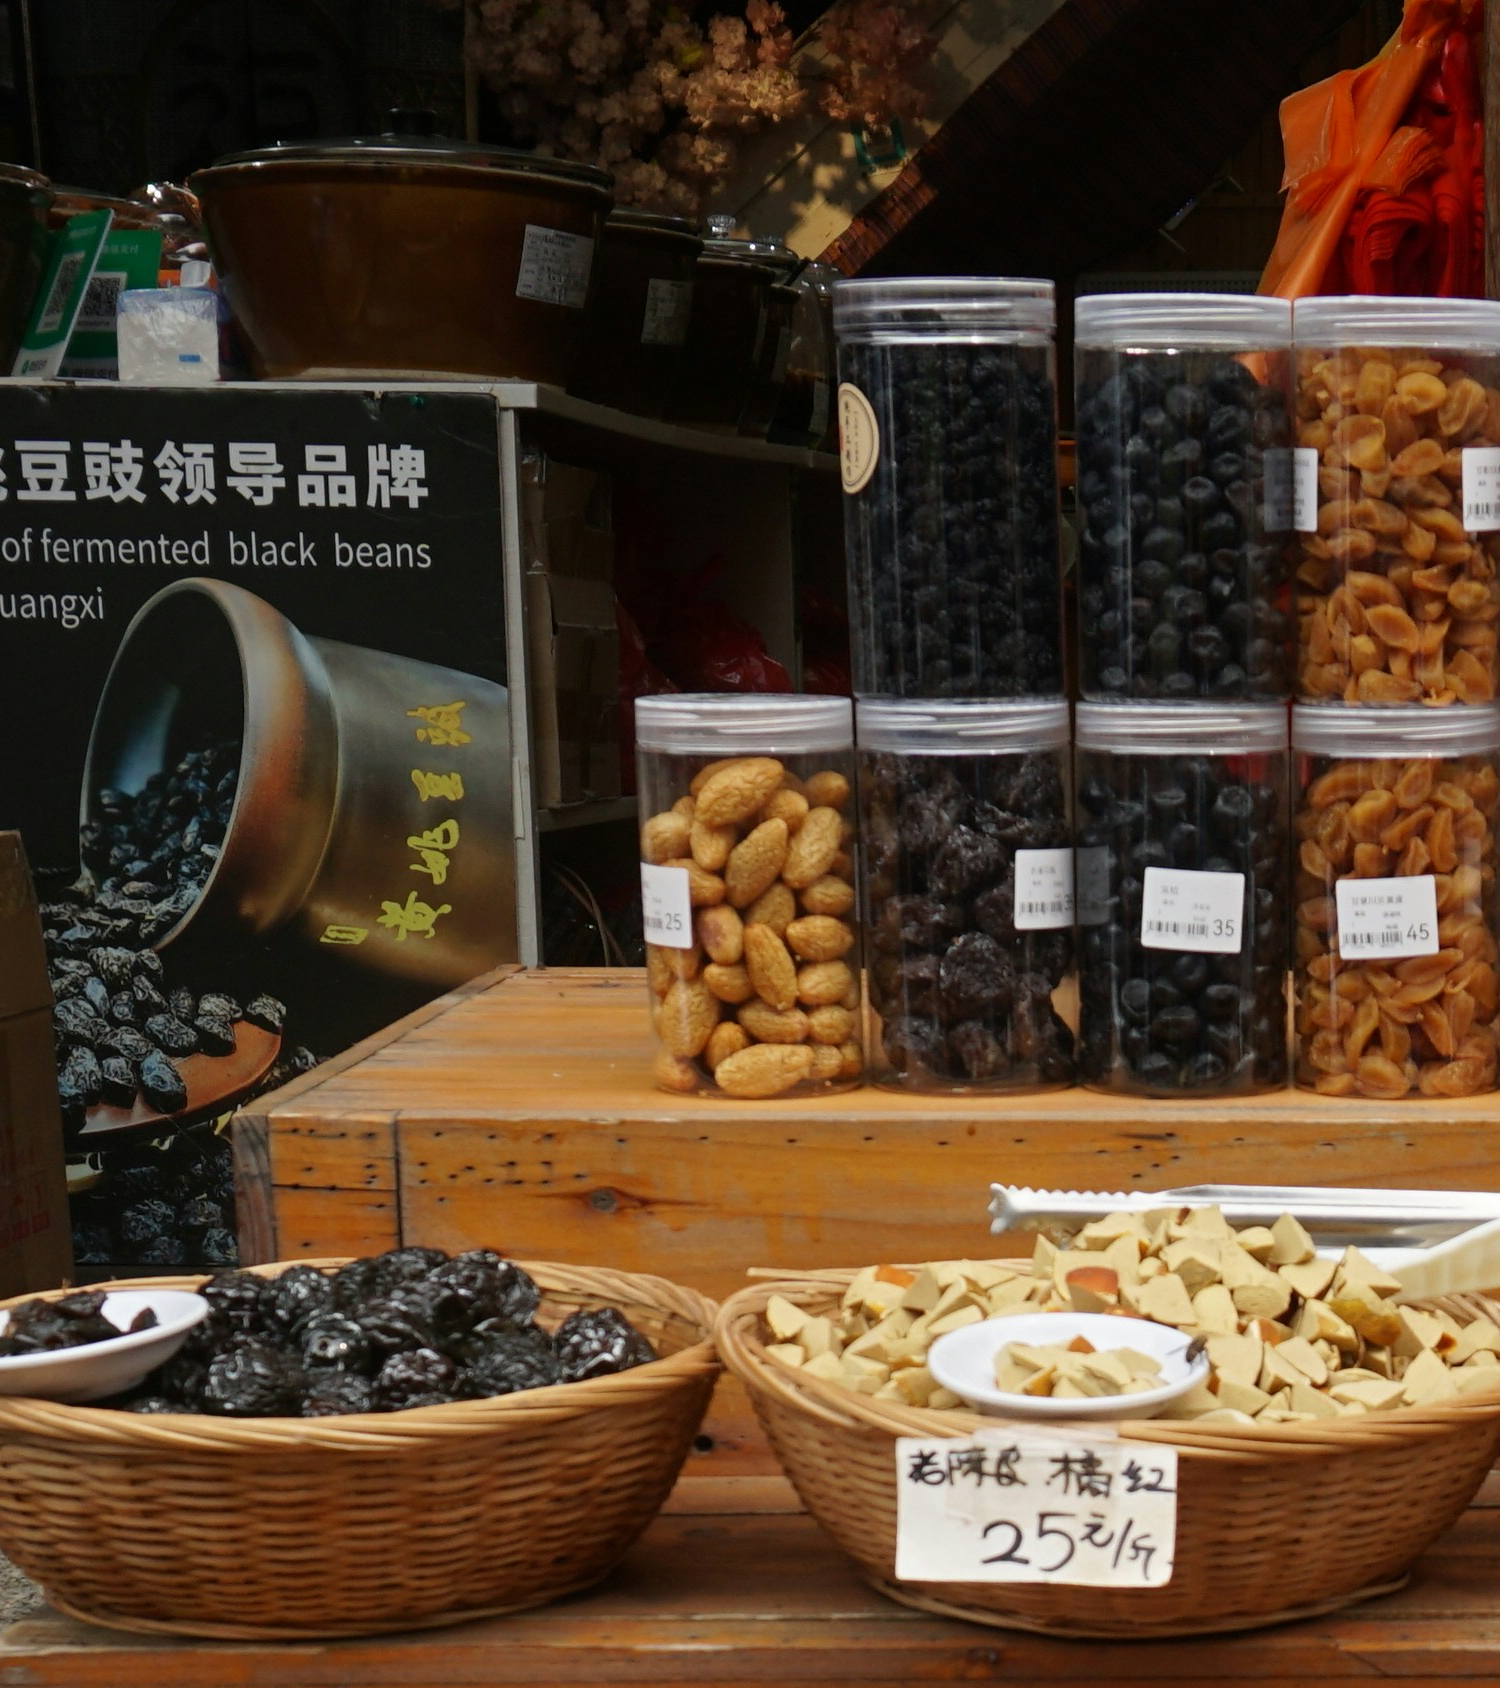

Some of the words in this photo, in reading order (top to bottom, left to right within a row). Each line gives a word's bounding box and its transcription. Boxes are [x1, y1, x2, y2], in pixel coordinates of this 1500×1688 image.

[1, 526, 32, 565] of
[41, 528, 211, 566] fermented
[230, 529, 317, 568] black
[334, 531, 432, 569] beans
[664, 912, 683, 931] 25
[1212, 918, 1235, 937] 35
[1406, 922, 1430, 941] 45
[980, 1510, 1159, 1581] 25元/斤
